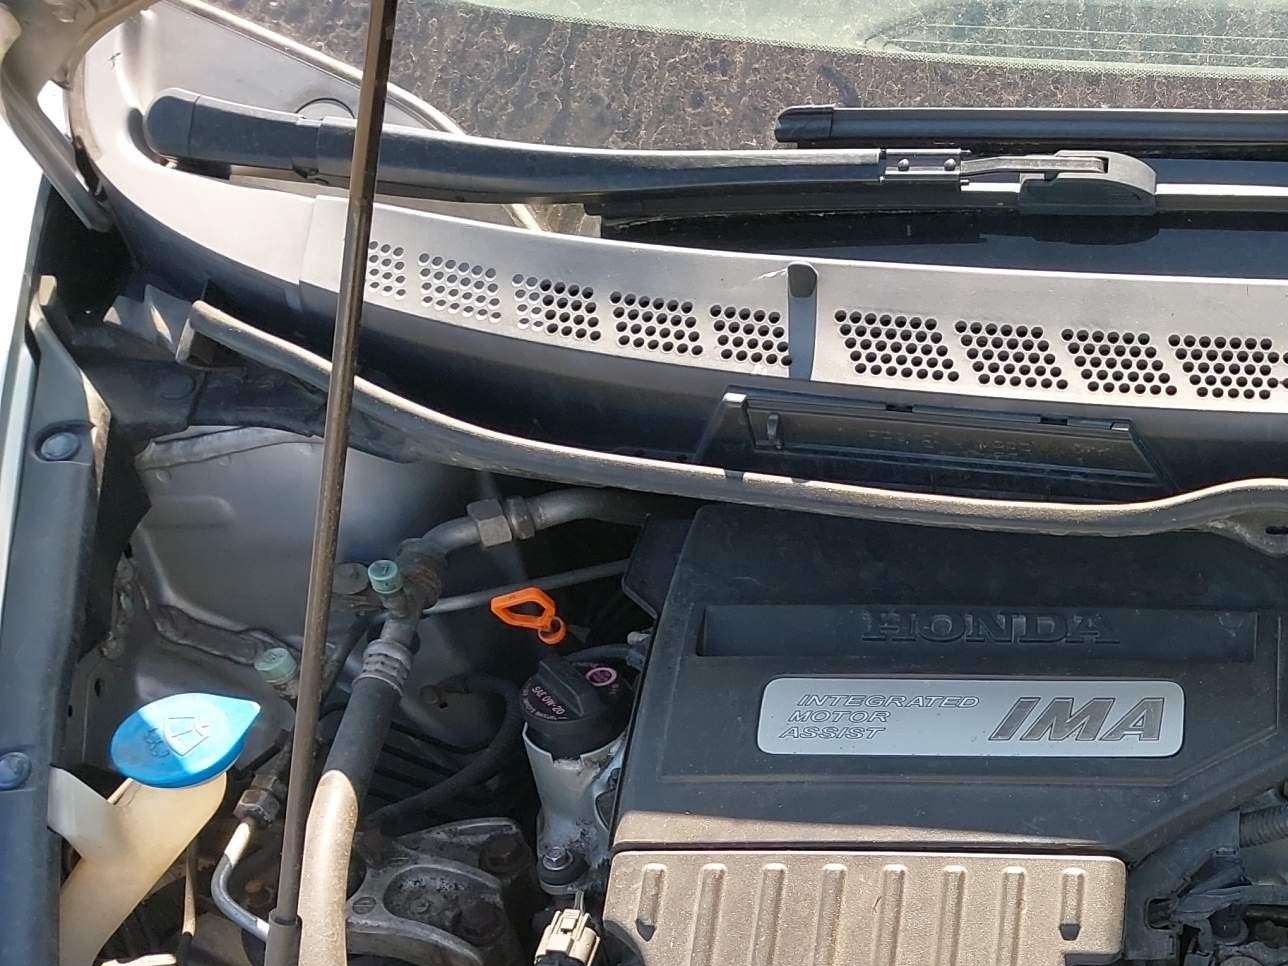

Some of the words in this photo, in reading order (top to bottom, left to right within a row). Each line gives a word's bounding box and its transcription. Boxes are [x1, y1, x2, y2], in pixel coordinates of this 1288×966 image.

[862, 608, 1121, 645] HONDA
[796, 694, 980, 708] INTEGRATED
[787, 710, 892, 723] MOTOR
[987, 697, 1165, 742] IMA
[778, 726, 887, 739] ASSIST
